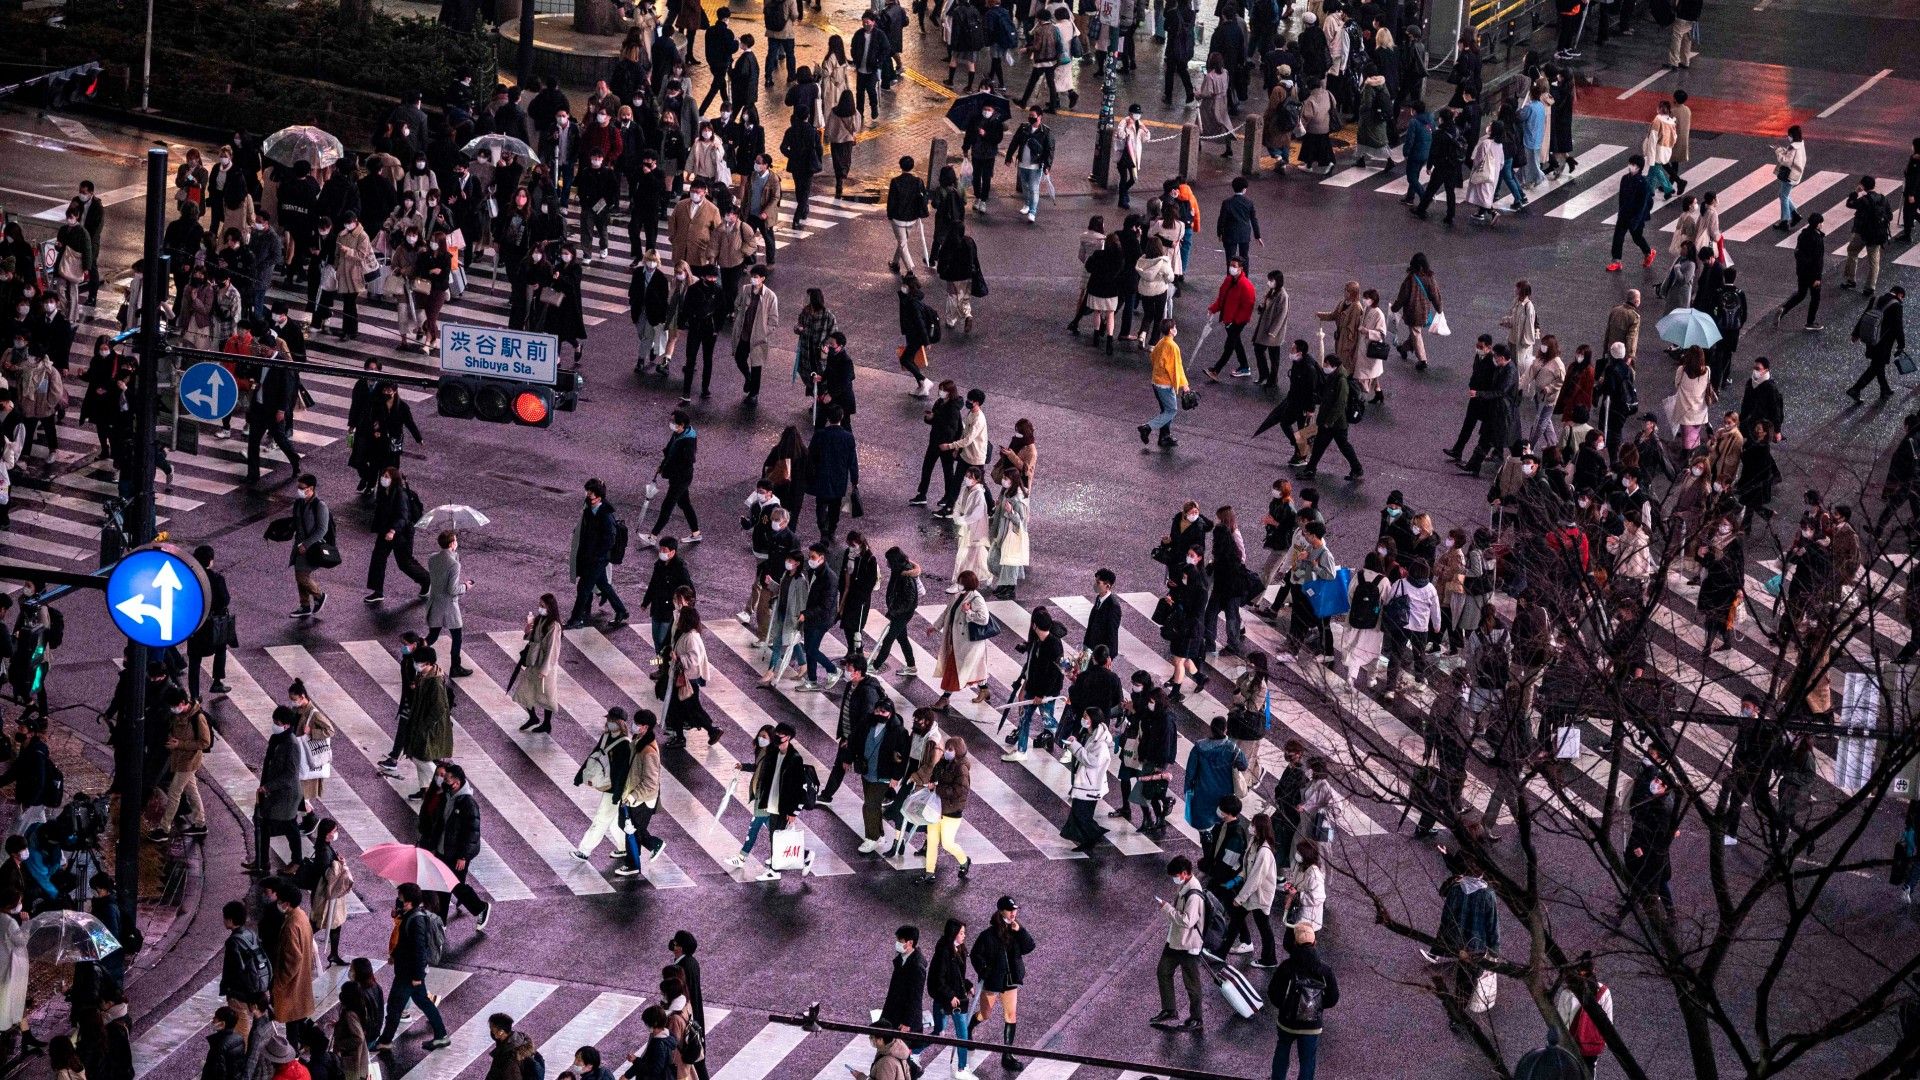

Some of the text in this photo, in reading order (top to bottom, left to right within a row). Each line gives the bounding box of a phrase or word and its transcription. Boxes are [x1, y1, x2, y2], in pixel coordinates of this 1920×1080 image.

[450, 331, 548, 362] 渋谷駅前
[465, 356, 535, 375] Shibuya Sta.
